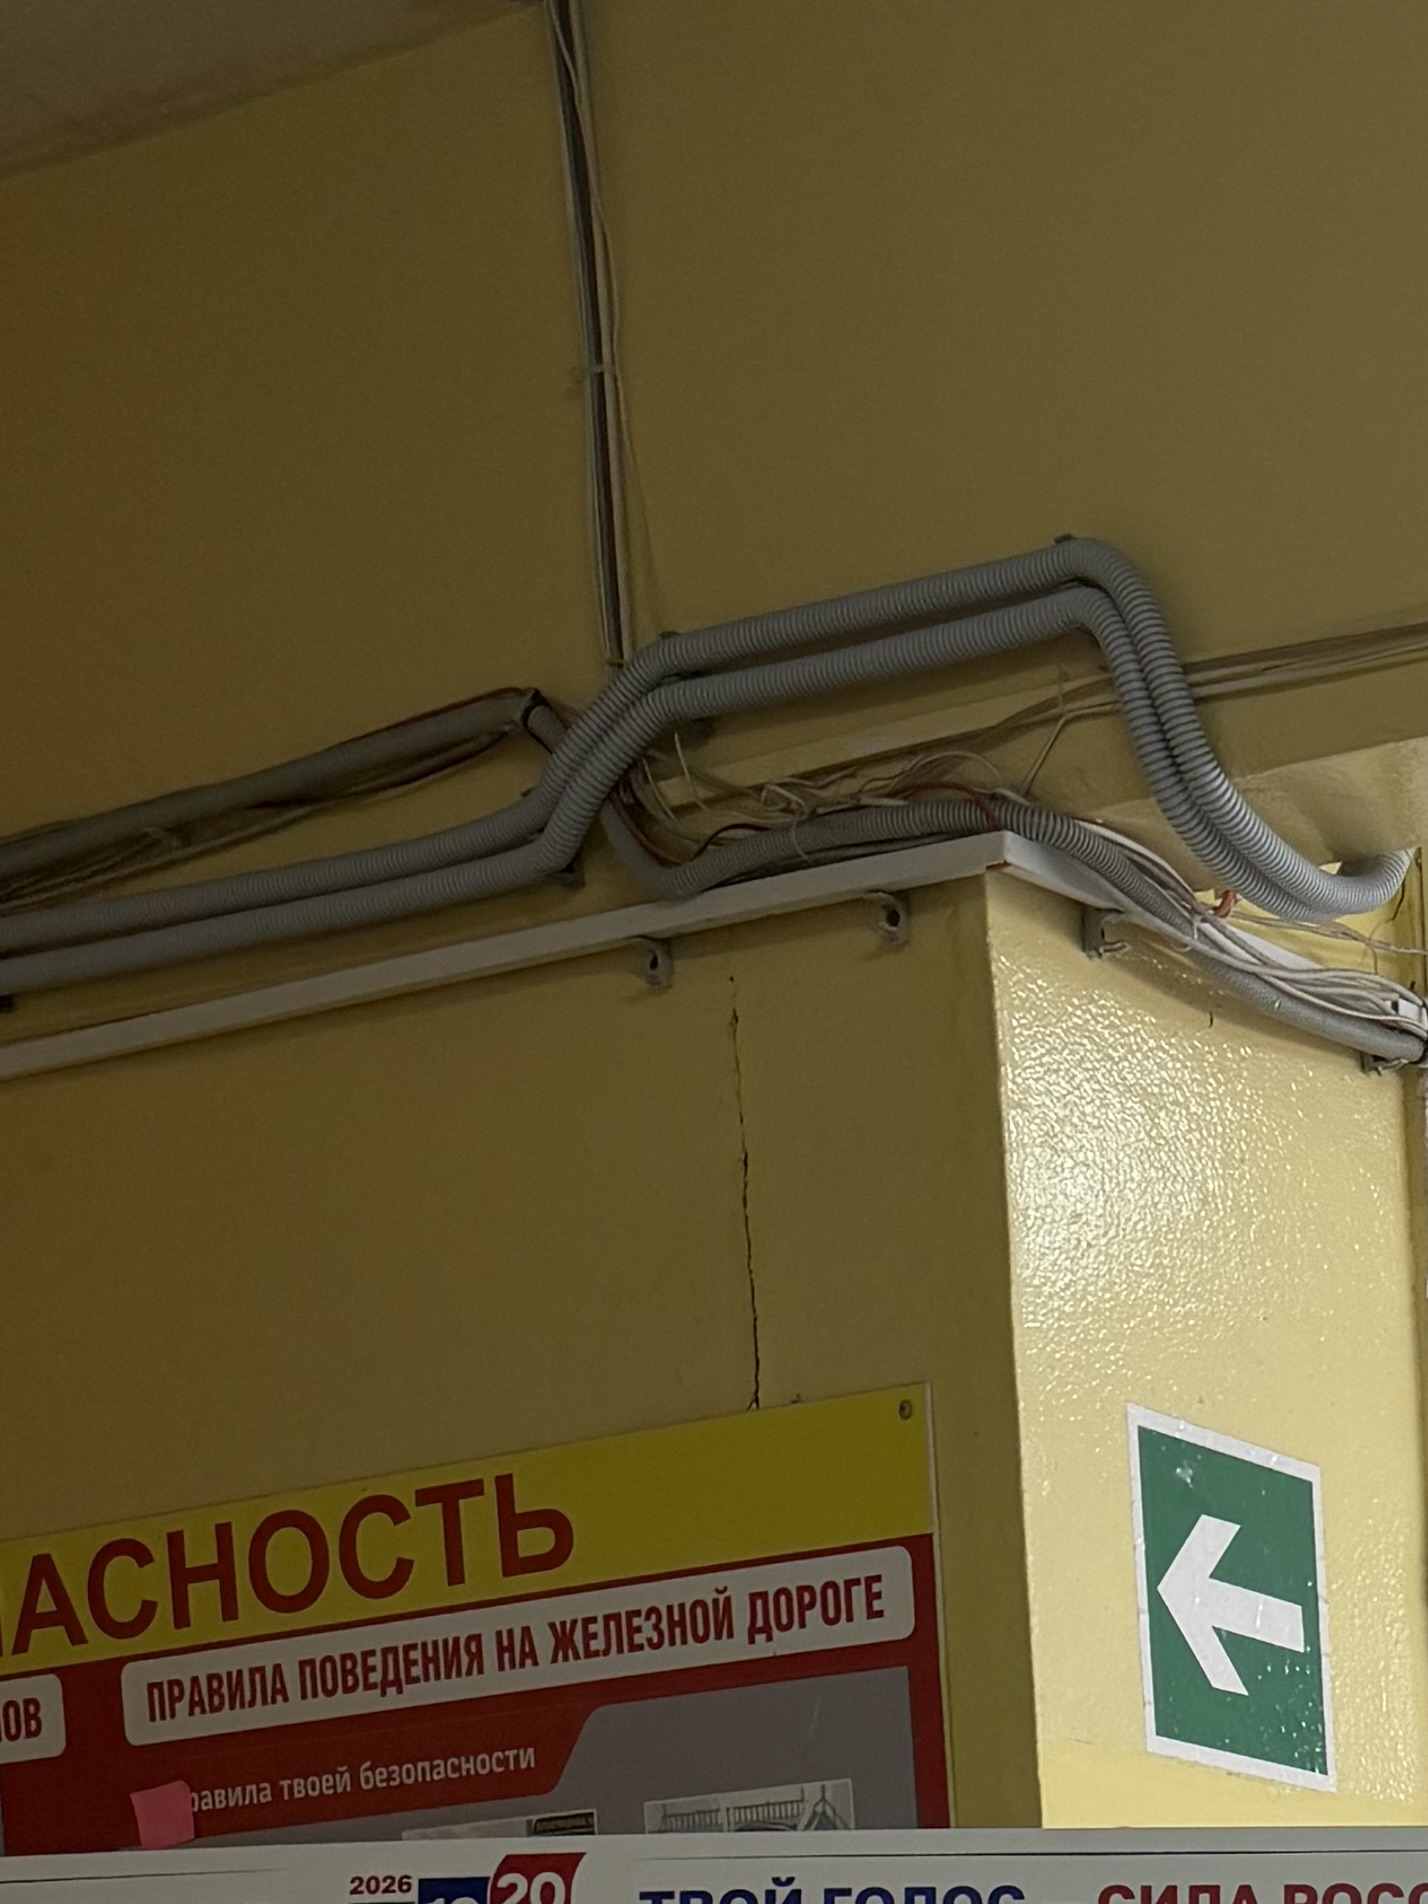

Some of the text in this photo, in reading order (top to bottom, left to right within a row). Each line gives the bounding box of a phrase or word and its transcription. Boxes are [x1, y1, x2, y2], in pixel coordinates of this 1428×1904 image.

[0, 1474, 575, 1657] АСНОСТЬ
[147, 1574, 885, 1723] ПРАВИЛА ПОВЕДЕНИЯ НА ЖЕЛЕЗНОЙ ДОРОГЕ
[0, 1698, 43, 1743] ОВ
[279, 1766, 352, 1799] твоей
[359, 1747, 536, 1788] безопасности
[349, 1875, 413, 1896] 2026
